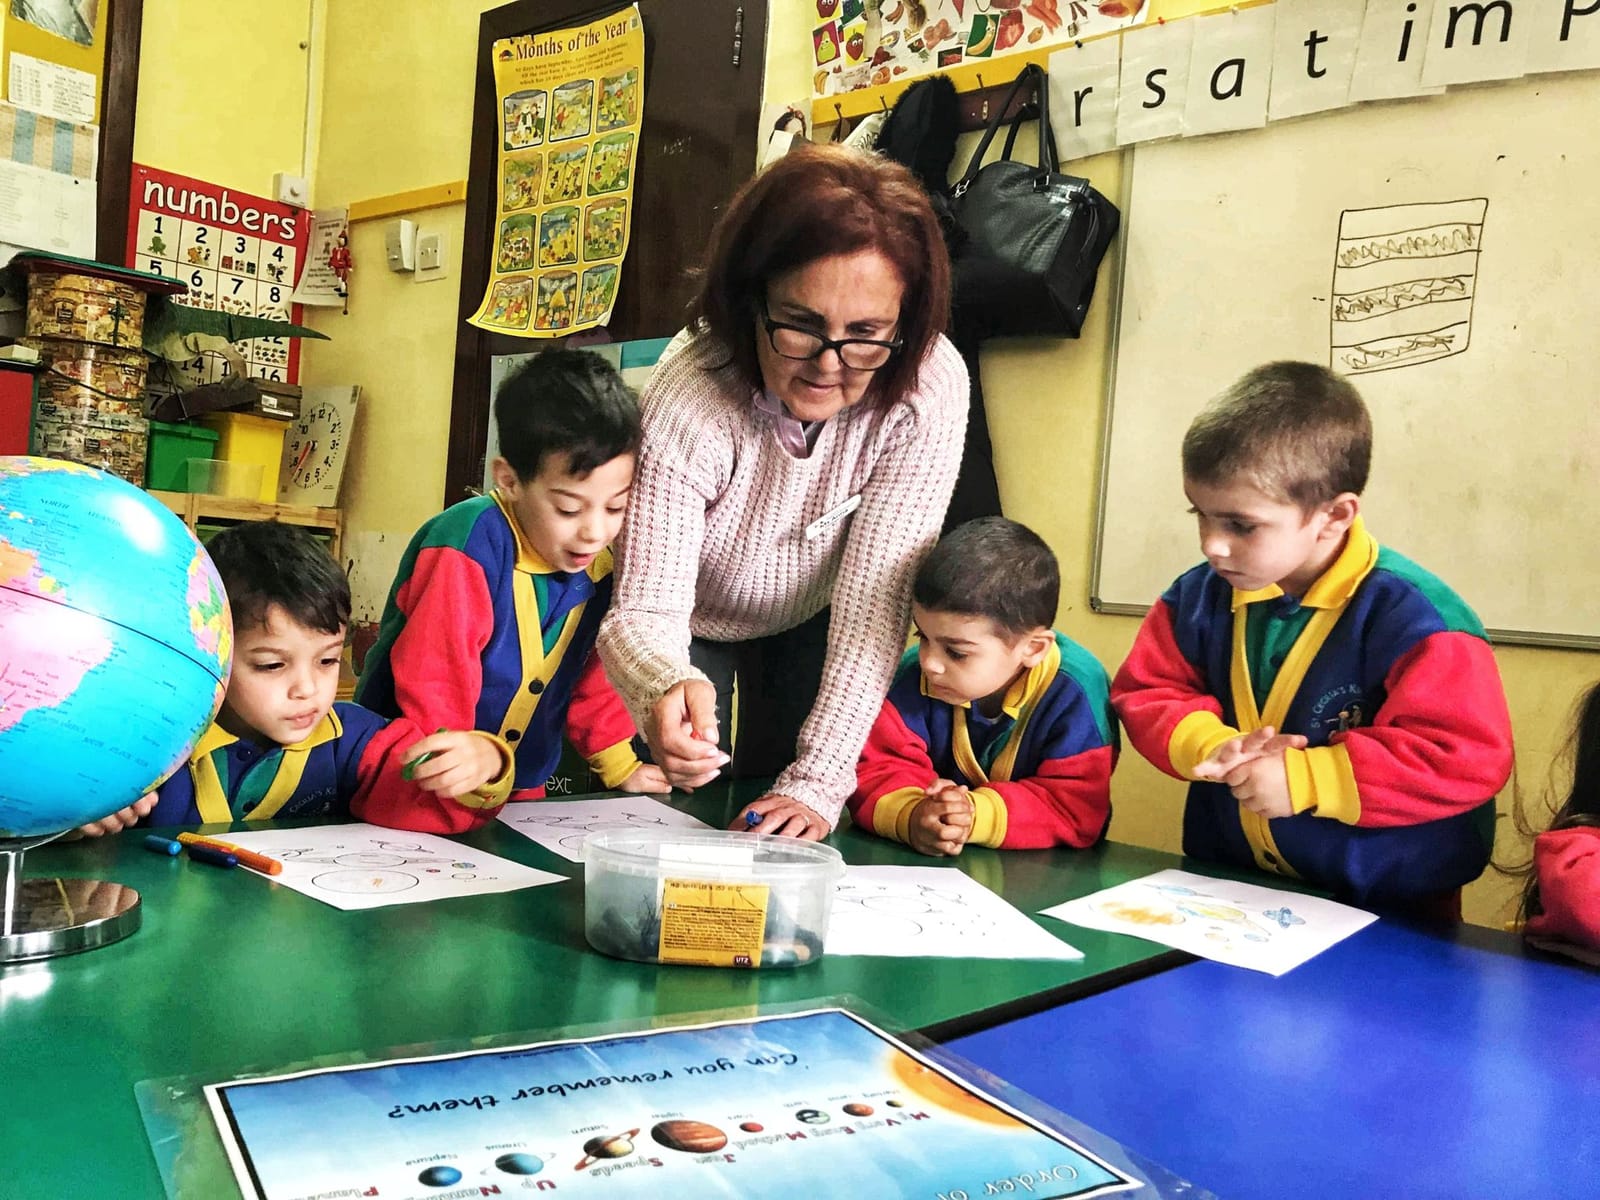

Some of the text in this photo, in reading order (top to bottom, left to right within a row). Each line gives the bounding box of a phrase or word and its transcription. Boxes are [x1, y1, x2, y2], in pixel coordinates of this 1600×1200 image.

[516, 37, 563, 60] Months
[568, 31, 584, 51] of
[584, 28, 600, 47] the
[605, 20, 628, 40] Year
[1073, 86, 1093, 127] r
[1142, 68, 1167, 109] s
[1210, 57, 1246, 100] a
[1303, 30, 1328, 78] t
[1397, 2, 1417, 62] i
[1444, 0, 1513, 49] m
[144, 179, 296, 240] numbers
[154, 216, 284, 262] 1 2 3 4
[150, 260, 281, 302] 5 6 7 8
[180, 356, 281, 383] 14 1 16
[318, 409, 326, 418] 12
[327, 413, 332, 422] 1
[330, 423, 337, 434] 2
[330, 440, 336, 450] 3
[324, 456, 330, 465] 4
[304, 472, 311, 483] 6
[314, 468, 320, 478] 5
[545, 775, 572, 794] ext
[388, 1053, 798, 1118] Can you remember them?
[521, 1177, 557, 1191] Up
[983, 1164, 1079, 1195] Order
